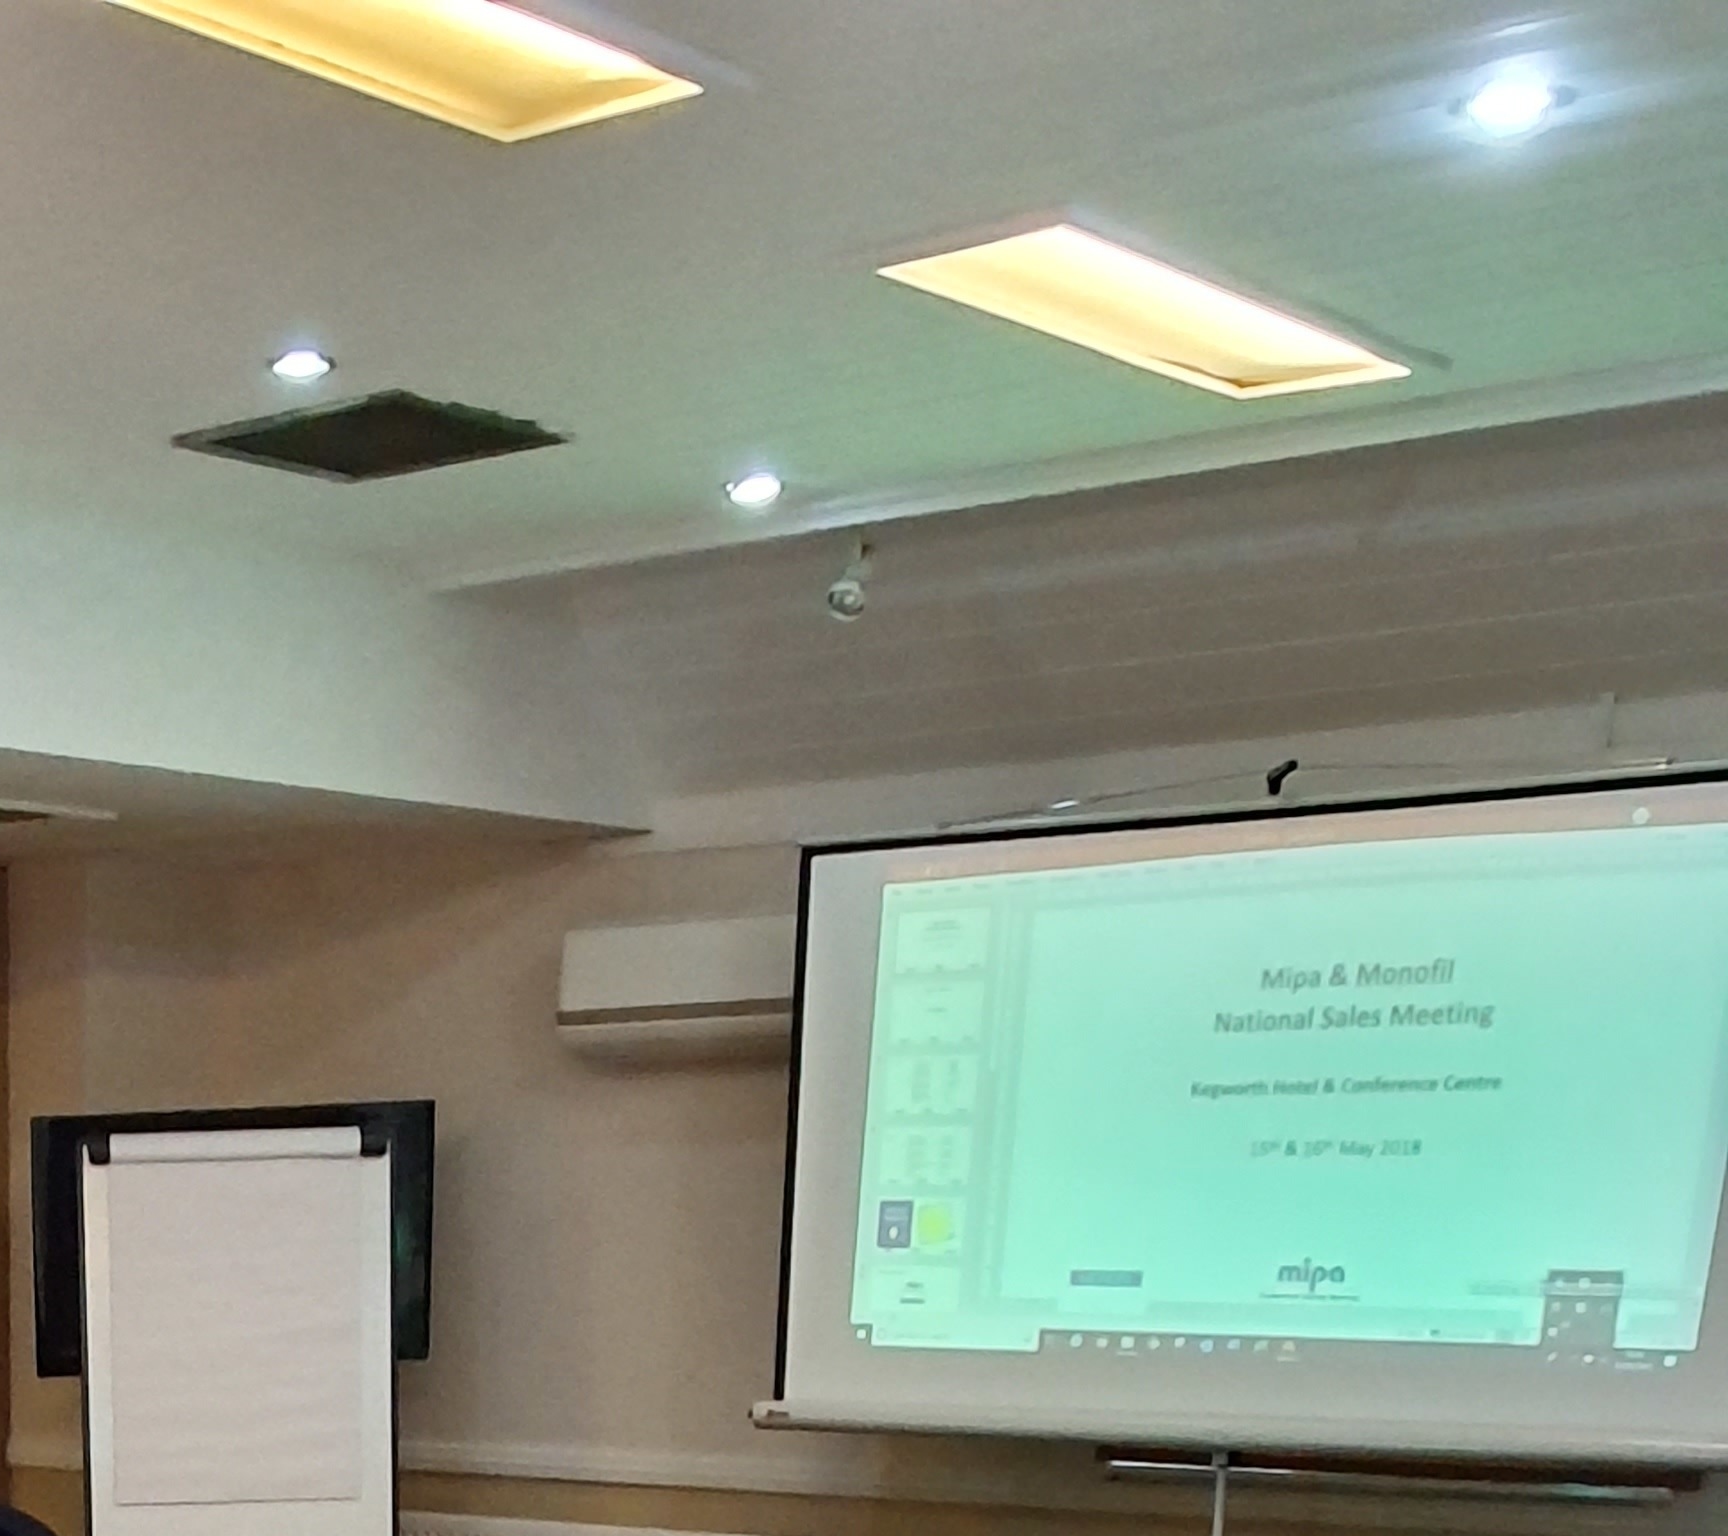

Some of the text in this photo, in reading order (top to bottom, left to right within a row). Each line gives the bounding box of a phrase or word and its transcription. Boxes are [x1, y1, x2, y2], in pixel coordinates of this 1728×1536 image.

[1260, 957, 1455, 994] Mipa & Monofil
[1213, 1001, 1496, 1033] National Sales Meeting
[1190, 1081, 1269, 1099] Kegworth
[1272, 1079, 1319, 1096] Hotel
[1340, 1076, 1439, 1094] Conference
[1443, 1074, 1503, 1092] Centre
[1339, 1140, 1374, 1158] May
[1379, 1139, 1423, 1157] 2018
[1276, 1256, 1345, 1293] mipa
